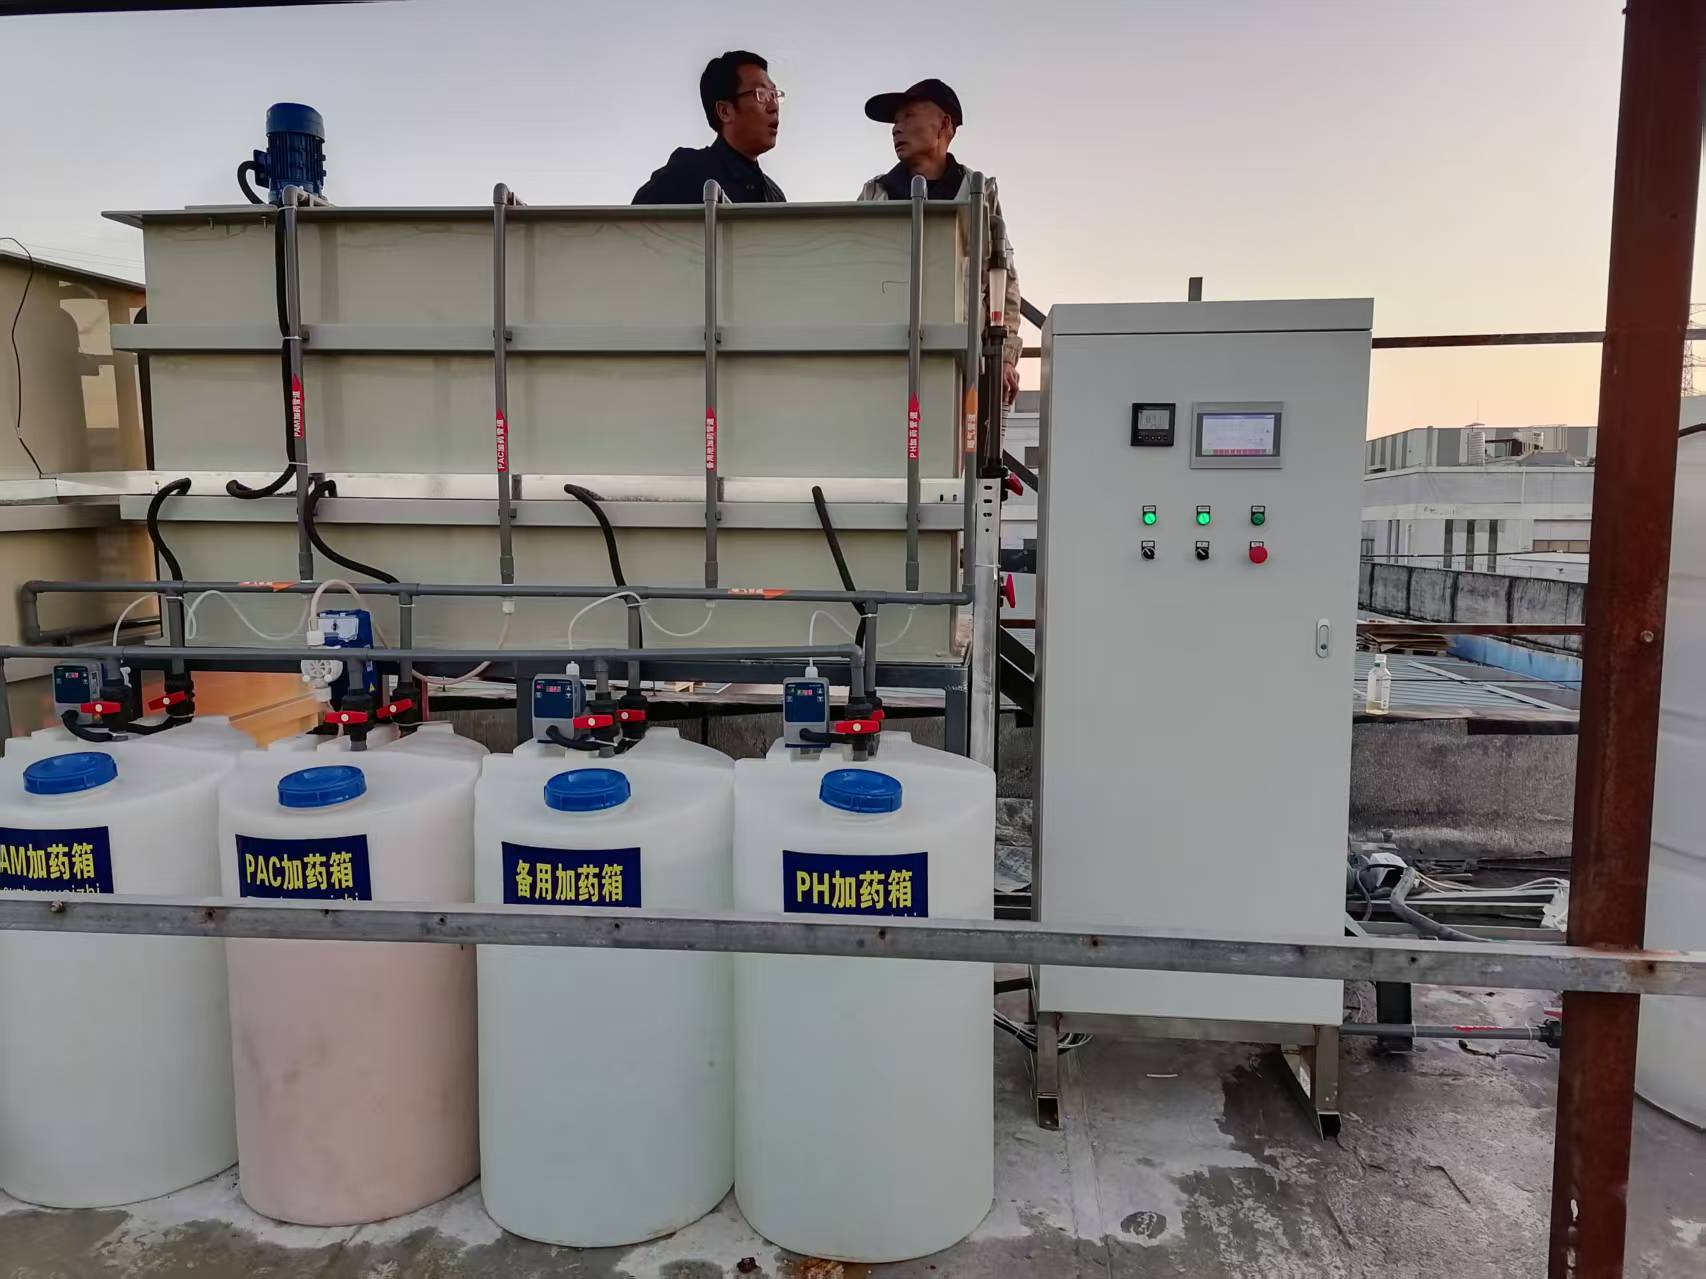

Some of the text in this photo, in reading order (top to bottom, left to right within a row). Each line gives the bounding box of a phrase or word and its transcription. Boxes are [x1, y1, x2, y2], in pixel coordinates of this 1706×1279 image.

[245, 851, 353, 890] PAC加药箱
[515, 859, 624, 903] 备用加药箱
[796, 869, 913, 910] PH加药箱
